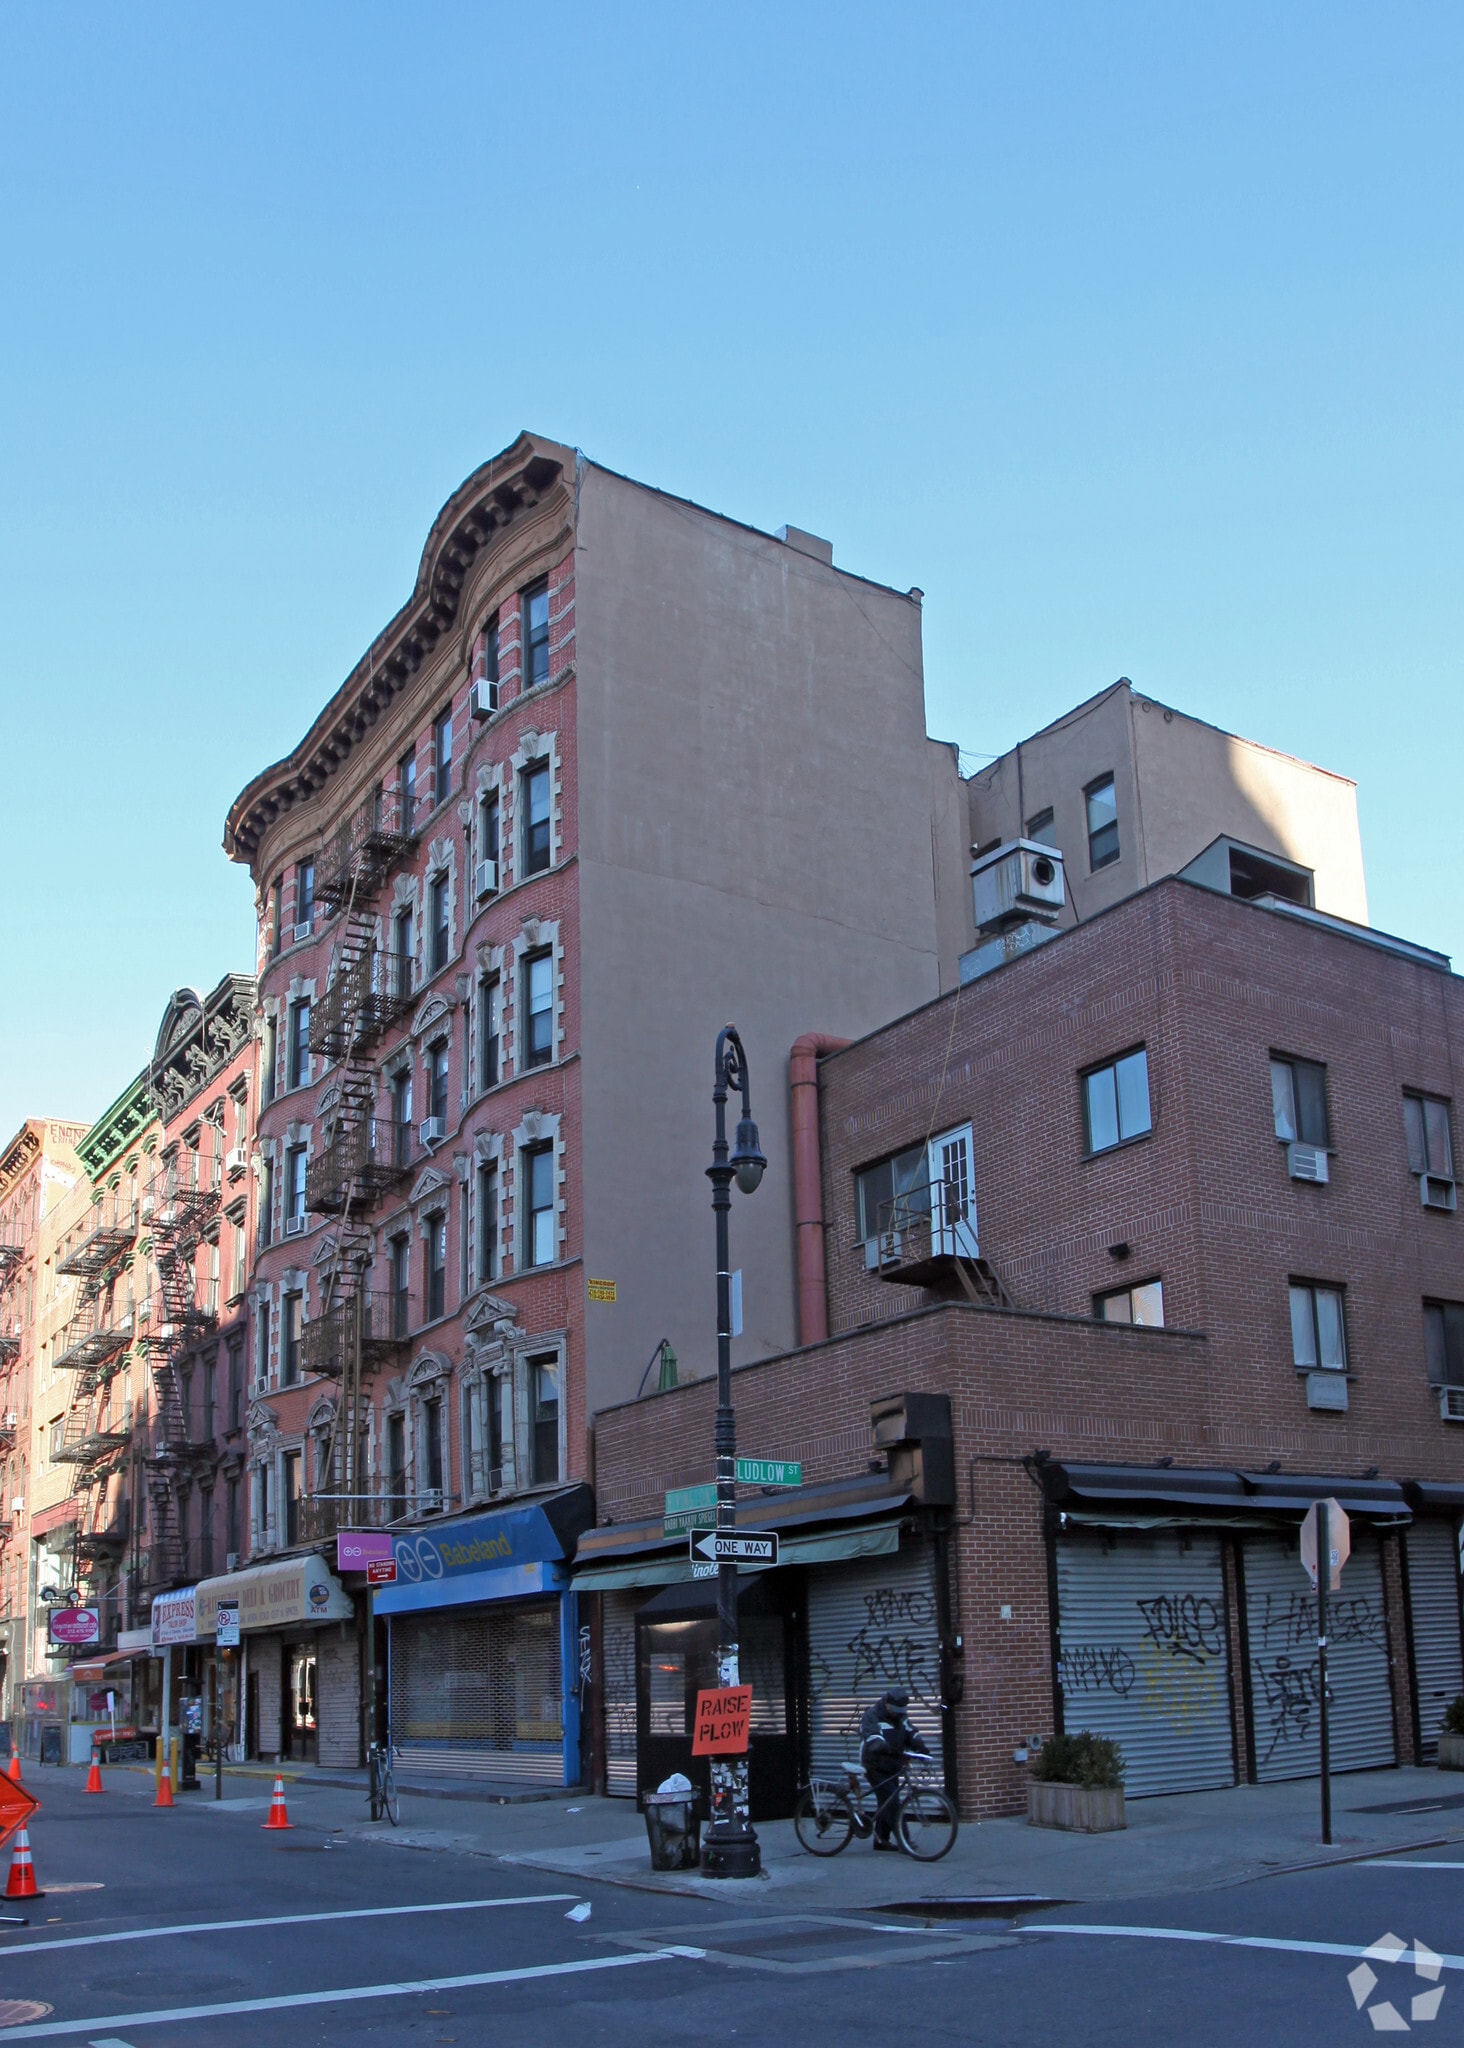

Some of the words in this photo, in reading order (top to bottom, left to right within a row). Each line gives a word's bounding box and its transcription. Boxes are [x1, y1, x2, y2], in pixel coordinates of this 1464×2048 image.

[737, 1461, 785, 1482] LUDLOW
[788, 1465, 799, 1475] ST
[438, 1531, 513, 1567] Babeland
[714, 1540, 738, 1554] ONE
[744, 1542, 769, 1555] WAY
[691, 1563, 719, 1578] 'inote
[162, 1599, 194, 1624] EXPRESS
[310, 1606, 328, 1614] ATM
[700, 1695, 749, 1717] RAISE
[699, 1719, 745, 1743] PLOW
